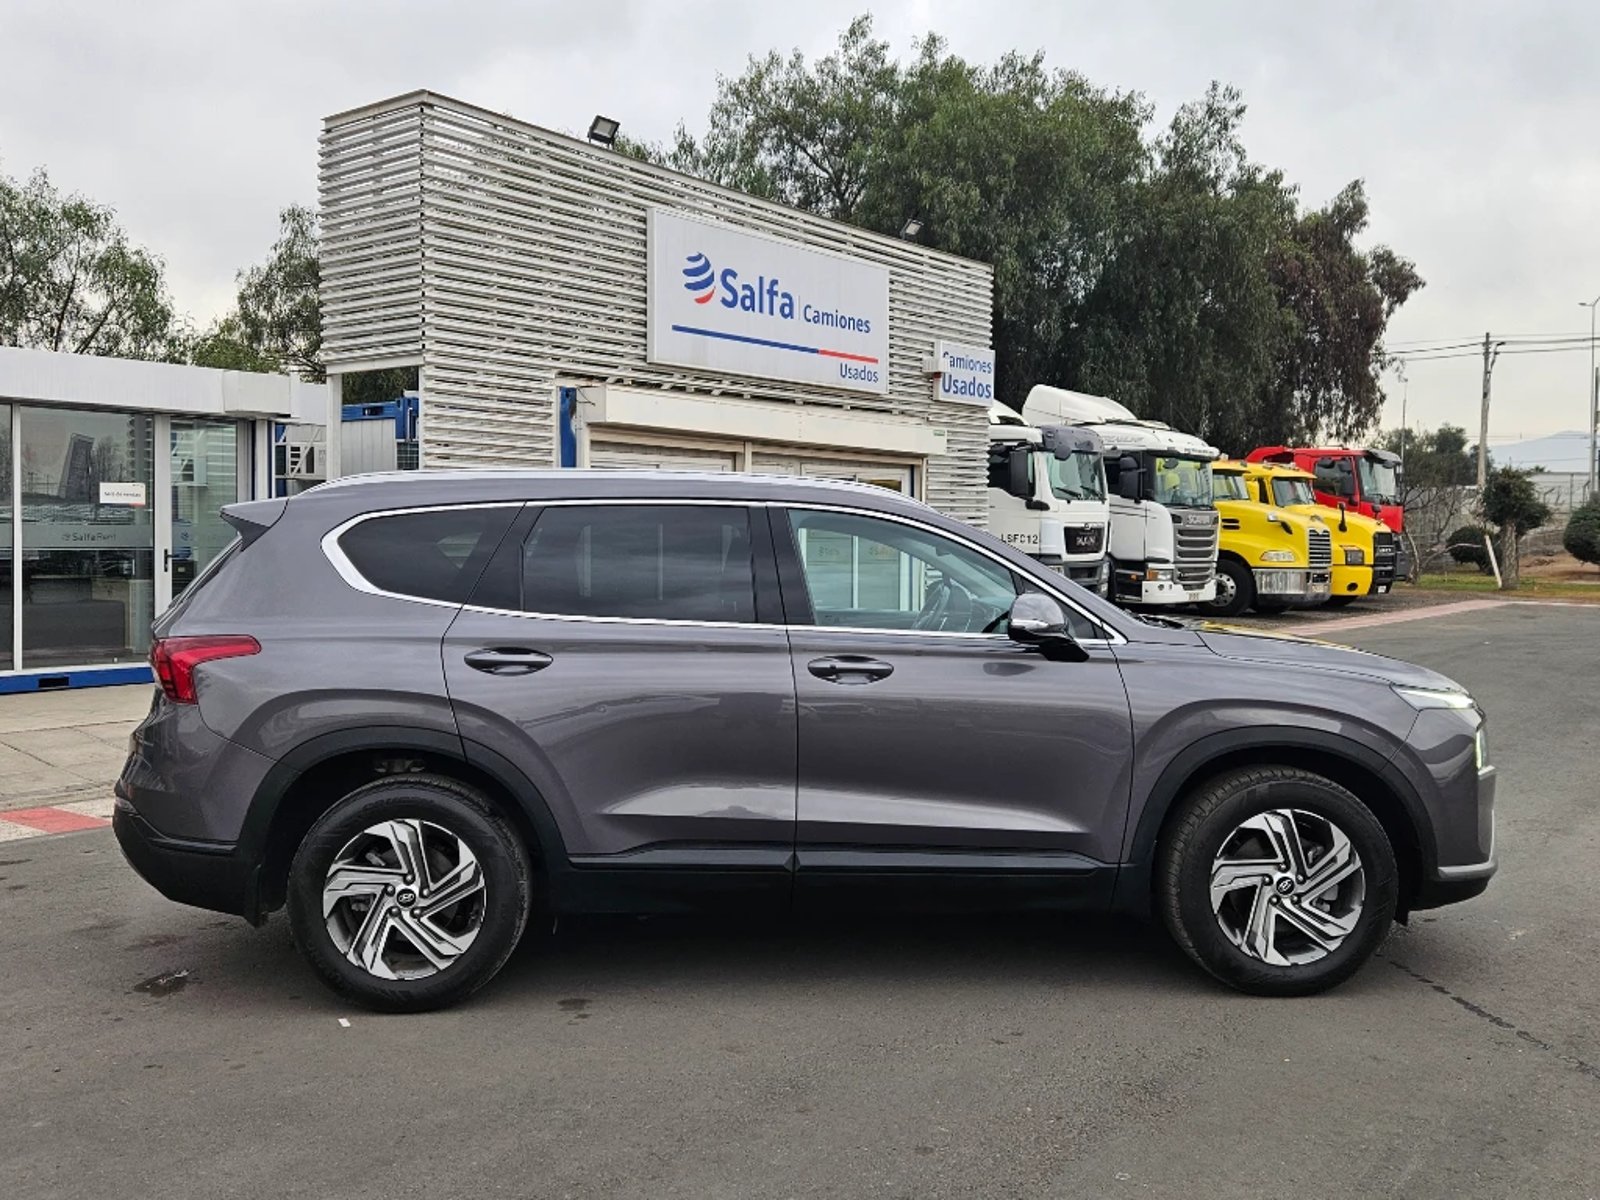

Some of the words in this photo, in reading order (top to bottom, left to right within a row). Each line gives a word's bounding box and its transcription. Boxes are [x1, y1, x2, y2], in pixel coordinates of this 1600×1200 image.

[720, 268, 794, 320] Salfa
[803, 304, 871, 334] Camiones
[840, 362, 879, 383] Usados
[942, 372, 992, 399] Usados
